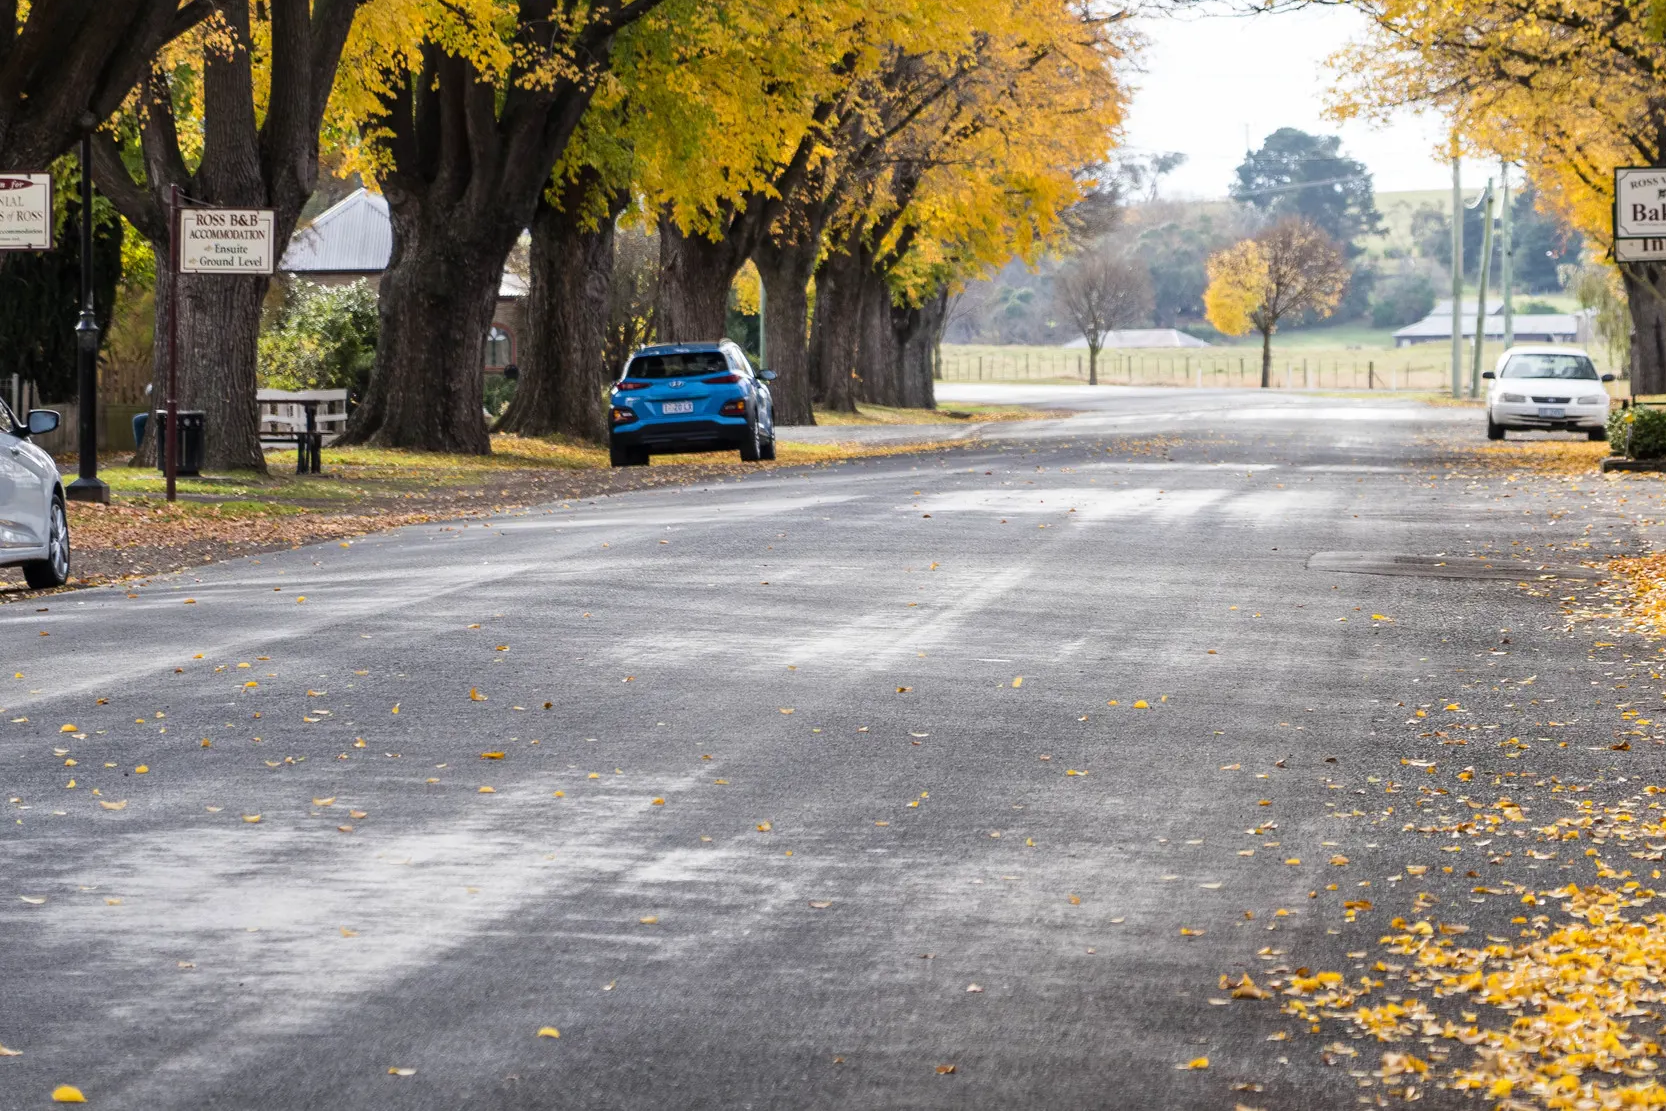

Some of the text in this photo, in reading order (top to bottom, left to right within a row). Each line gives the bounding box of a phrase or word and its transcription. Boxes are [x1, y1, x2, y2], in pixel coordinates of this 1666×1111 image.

[1630, 177, 1659, 189] ROSS
[16, 210, 43, 222] ROSS
[196, 214, 259, 226] ROSS B&B
[189, 229, 266, 239] ACCOMMODATION
[214, 244, 249, 254] Ensuite
[200, 257, 262, 266] Ground Level
